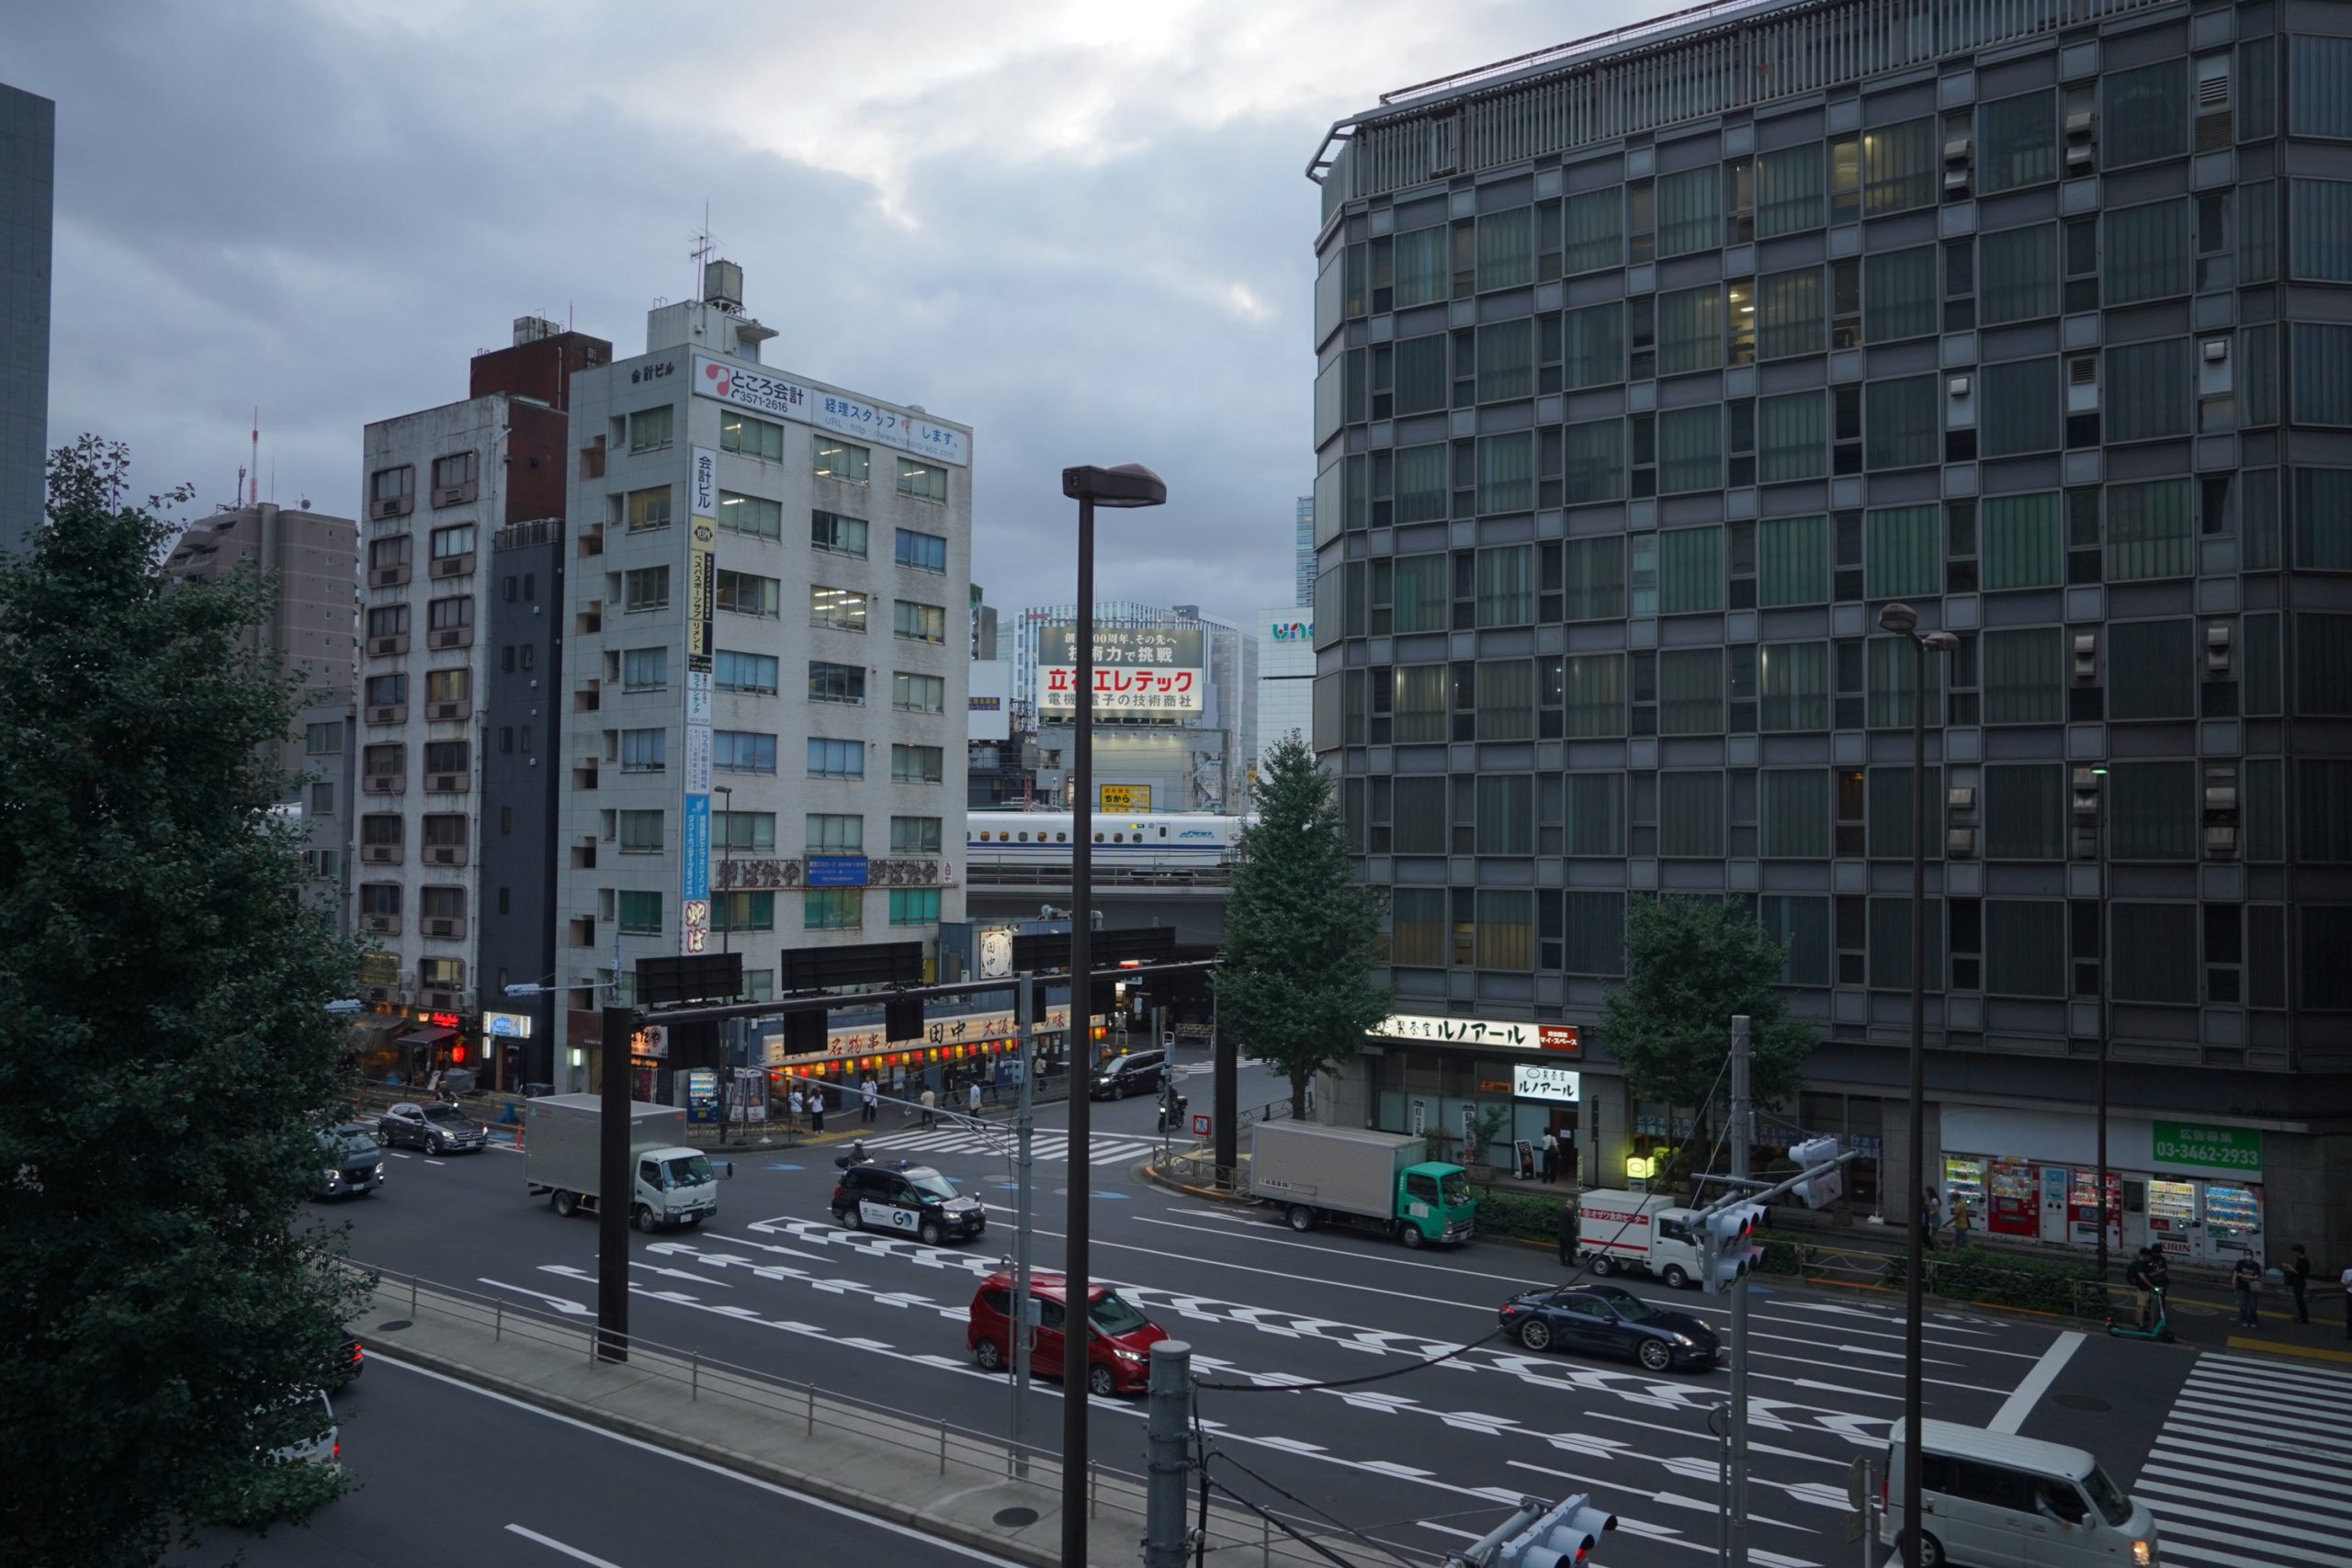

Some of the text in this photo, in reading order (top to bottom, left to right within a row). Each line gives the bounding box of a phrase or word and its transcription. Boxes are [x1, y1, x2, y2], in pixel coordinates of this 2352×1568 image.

[631, 361, 674, 384] 会計ビル
[731, 370, 804, 406] ところ会計
[740, 390, 788, 412] 3571-2616
[825, 397, 957, 448] 経理スタッフします。
[698, 456, 712, 509] 会計ビル
[1065, 633, 1177, 645] 創00周年、その先へ
[1048, 693, 1192, 707] 電機電子の技術商社
[1104, 795, 1130, 803] ちから
[929, 1021, 966, 1044] 田中
[983, 1010, 1065, 1037] 大阪味
[1438, 1020, 1526, 1045] ルノアール
[1540, 1036, 1577, 1045] マイ・スペース
[1519, 1080, 1574, 1097] ルノアール
[2180, 1128, 2233, 1145] 広告募集
[2156, 1141, 2258, 1166] 03-3462-2933
[892, 1211, 912, 1227] GO
[2160, 1242, 2191, 1253] KIRIN
